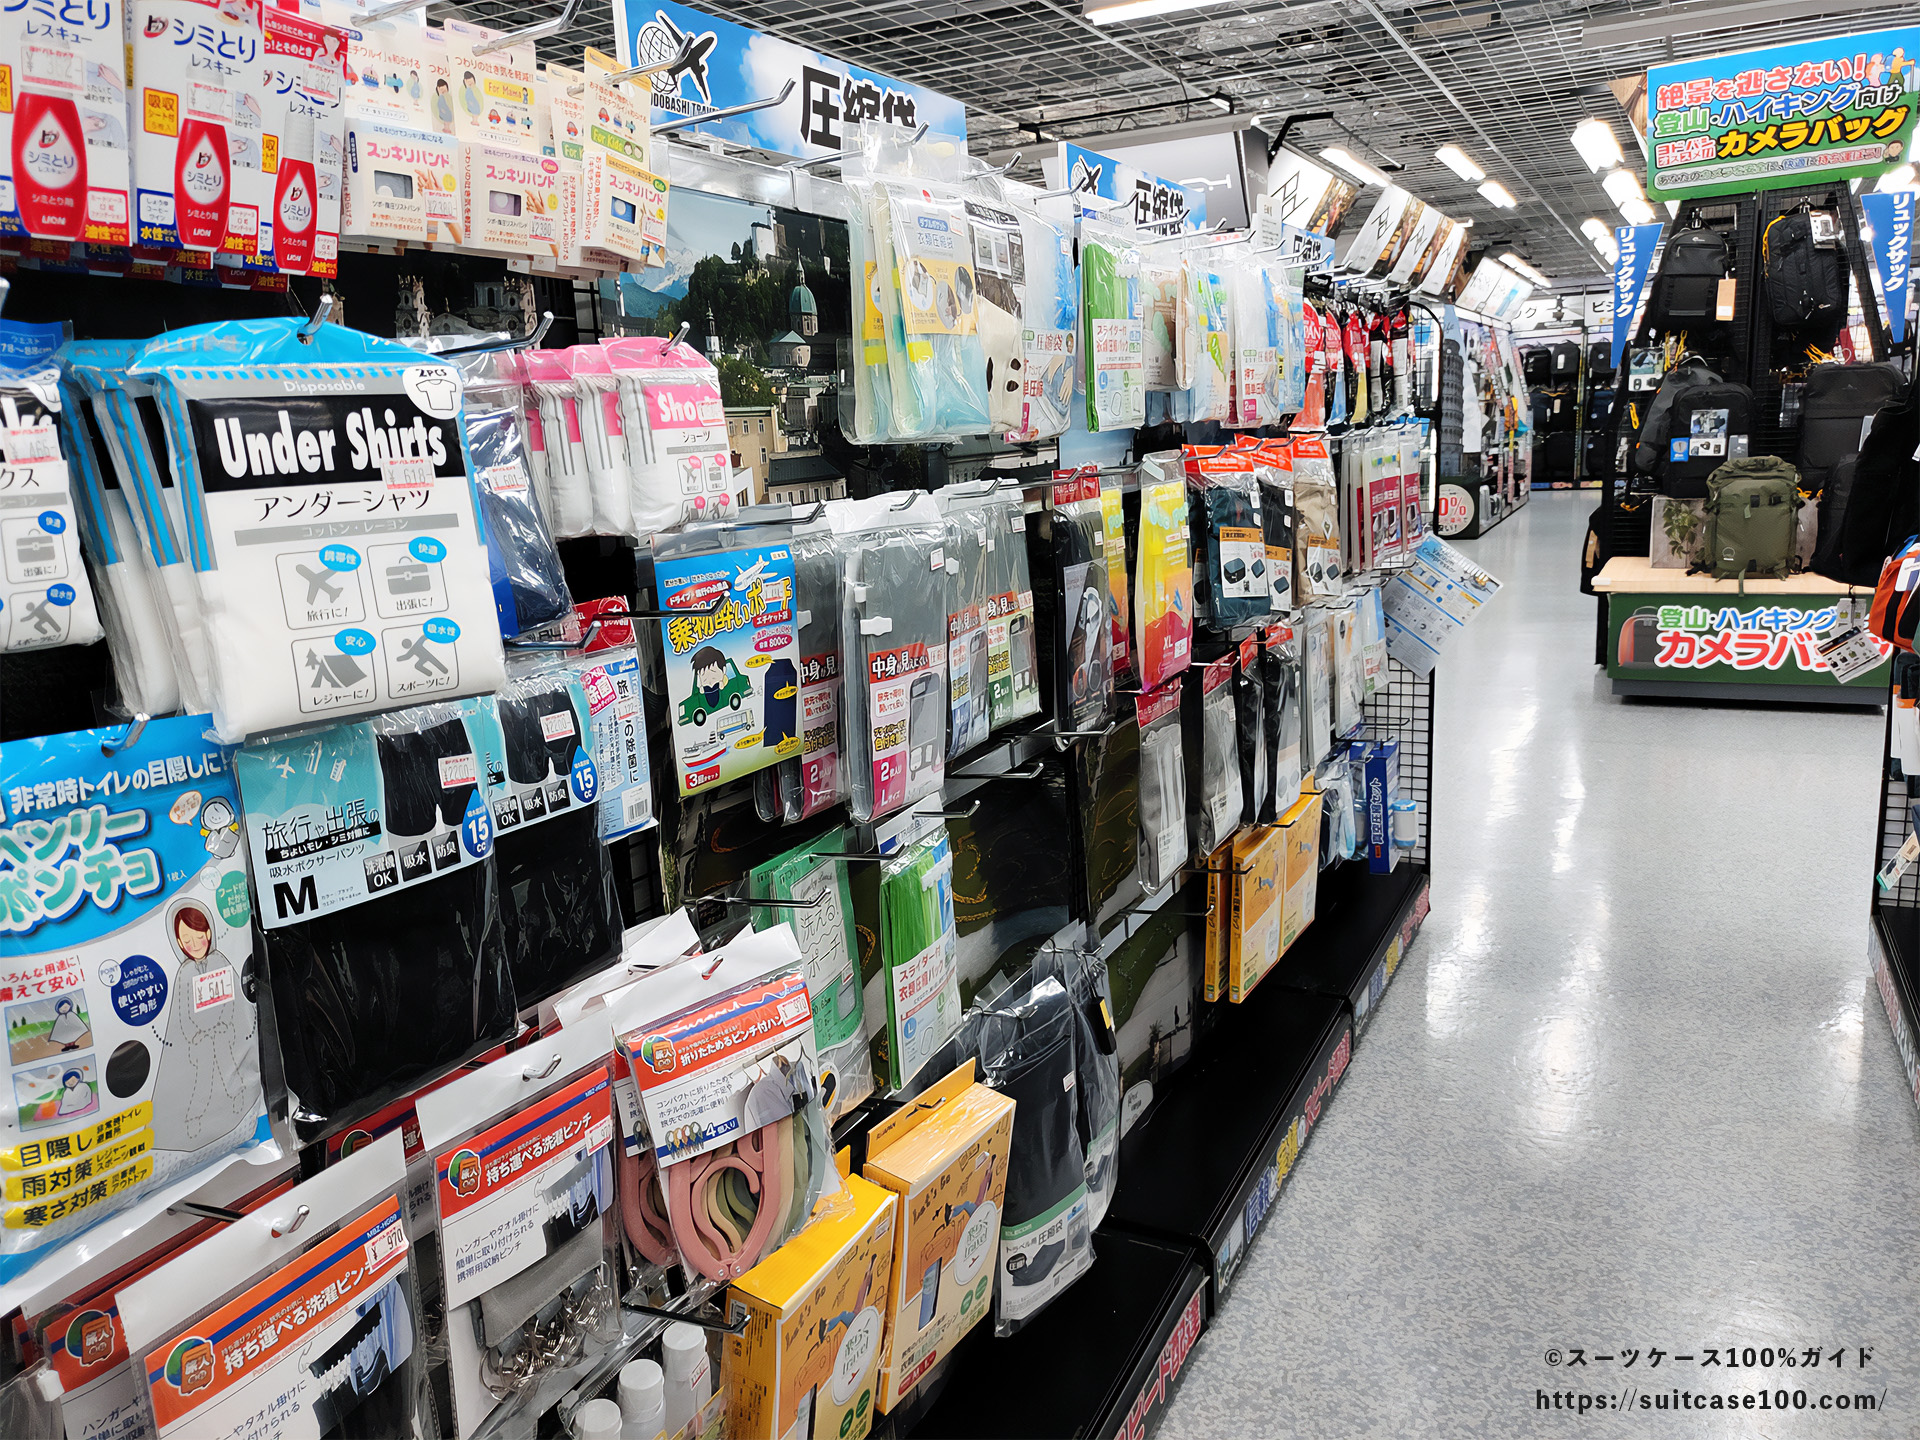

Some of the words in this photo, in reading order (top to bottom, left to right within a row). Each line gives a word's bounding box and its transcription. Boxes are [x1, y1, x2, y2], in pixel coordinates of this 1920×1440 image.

[27, 20, 92, 43] レスキュー
[173, 18, 256, 63] シミとり
[191, 53, 241, 75] レスキュー
[488, 82, 500, 93] For
[502, 85, 522, 98] Mama
[1657, 53, 1868, 112] 絶景を逃さない!
[148, 93, 175, 111] 吸収
[290, 101, 328, 119] レスキュー
[1654, 82, 1902, 139] 登山・ハイキング向け
[592, 129, 605, 142] For
[607, 134, 622, 150] Kids
[1717, 104, 1910, 159] カメラバッグ
[367, 142, 449, 168] スッキリバンド
[1657, 137, 1716, 157] ヨドバシ
[29, 151, 74, 168] シミとり
[187, 171, 222, 187] シミとり
[486, 164, 555, 188] スッキリバンド
[149, 213, 166, 221] ワイン
[187, 208, 219, 221] シミとり剤
[284, 204, 310, 217] シミとり
[1136, 179, 1184, 236] 圧縮袋
[42, 215, 66, 225] LION
[84, 224, 111, 240] 油性
[140, 226, 163, 241] 水性
[193, 228, 211, 237] LION
[224, 236, 244, 250] 油性
[1884, 193, 1911, 292] リュックサック
[286, 253, 301, 261] LION
[312, 261, 327, 272] 油性
[1615, 227, 1636, 318] リュックサック
[418, 368, 447, 378] 2PCS
[284, 380, 365, 393] Disposable
[213, 409, 336, 479] Under
[345, 407, 447, 472] Shirts
[682, 430, 711, 443] ショーツ
[254, 489, 431, 522] アンダーシャツ
[301, 517, 409, 539] コットン・レーヨン
[418, 542, 438, 556] 快適
[1433, 547, 1456, 566] Vacuum
[1421, 546, 1457, 574] Compressor
[23, 565, 57, 577] 出張に!
[306, 606, 349, 622] 旅行に!
[396, 597, 434, 611] 出張に!
[756, 611, 789, 625] エチケット袋
[1659, 606, 1839, 633] 登山・ハイキング
[427, 623, 456, 637] 吸水性
[345, 636, 366, 648] 安心
[769, 636, 788, 647] 800cc
[1163, 635, 1174, 649] XL
[872, 650, 928, 679] 中身が見えにくい
[396, 676, 450, 692] スポーツに!
[994, 683, 1001, 699] 2
[313, 688, 370, 706] レジャーに!
[878, 699, 905, 713] 開いても安心
[874, 729, 907, 751] 色付き加工
[576, 768, 595, 790] 15
[810, 764, 818, 783] 2
[880, 761, 890, 782] 2
[10, 752, 230, 816] 非常時トイレの目隠しに!
[549, 787, 566, 801] 防臭
[494, 798, 518, 816] 洗濯機
[524, 796, 543, 812] 吸水
[263, 798, 380, 851] 旅行や出張の
[501, 811, 516, 825] OK
[468, 815, 489, 844] 15
[279, 828, 371, 859] ちょいモレ・シミ対策に
[436, 841, 457, 860] 防臭
[269, 843, 367, 878] 吸水ボクサーパンツ
[366, 854, 395, 876] 洗濯機
[403, 851, 427, 869] 吸水
[167, 870, 187, 882] 1枚入
[374, 872, 393, 888] OK
[274, 875, 319, 919] M
[807, 931, 845, 980] ポーチ!
[899, 944, 941, 983] スライダー付
[100, 964, 118, 976] POINT
[109, 974, 115, 983] 2
[123, 964, 149, 979] しゃがむと
[898, 959, 944, 1002] 衣類圧縮パック
[118, 983, 164, 1009] 使いやすい
[197, 987, 203, 1003] ¥
[208, 982, 231, 999] 541-
[130, 998, 158, 1018] 三角形
[908, 1023, 915, 1035] L
[680, 1016, 784, 1067] 折りたためるピンチ付ハン
[655, 1048, 673, 1061] 旅人
[658, 1083, 733, 1118] ホテルのハンガー不足や
[660, 1095, 729, 1128] 旅先での洗濯に便利!
[705, 1123, 717, 1137] 4
[717, 1120, 736, 1134] 個入り
[20, 1134, 93, 1168] 目隠し
[485, 1111, 592, 1186] 持ち運べる洗濯ピンチ
[22, 1157, 93, 1199] 雨対策
[97, 1144, 127, 1162] レジャー
[112, 1168, 148, 1193] アウトドア
[461, 1165, 478, 1182] 旅人
[23, 1179, 108, 1227] 寒さ対策
[912, 1186, 938, 1226] Let's
[940, 1173, 951, 1191] Go
[455, 1203, 540, 1257] ハンガーやタオル掛けに
[1038, 1218, 1063, 1246] 圧縮袋
[371, 1245, 378, 1261] ¥
[387, 1228, 404, 1250] 970
[455, 1219, 535, 1271] 簡単に取り付けられる
[1006, 1236, 1037, 1254] トラベル用
[456, 1240, 522, 1284] 携帯用収納ピンチ
[785, 1304, 812, 1352] Let's
[814, 1285, 826, 1303] Go
[85, 1326, 110, 1352] 旅人
[185, 1352, 211, 1377] 旅人
